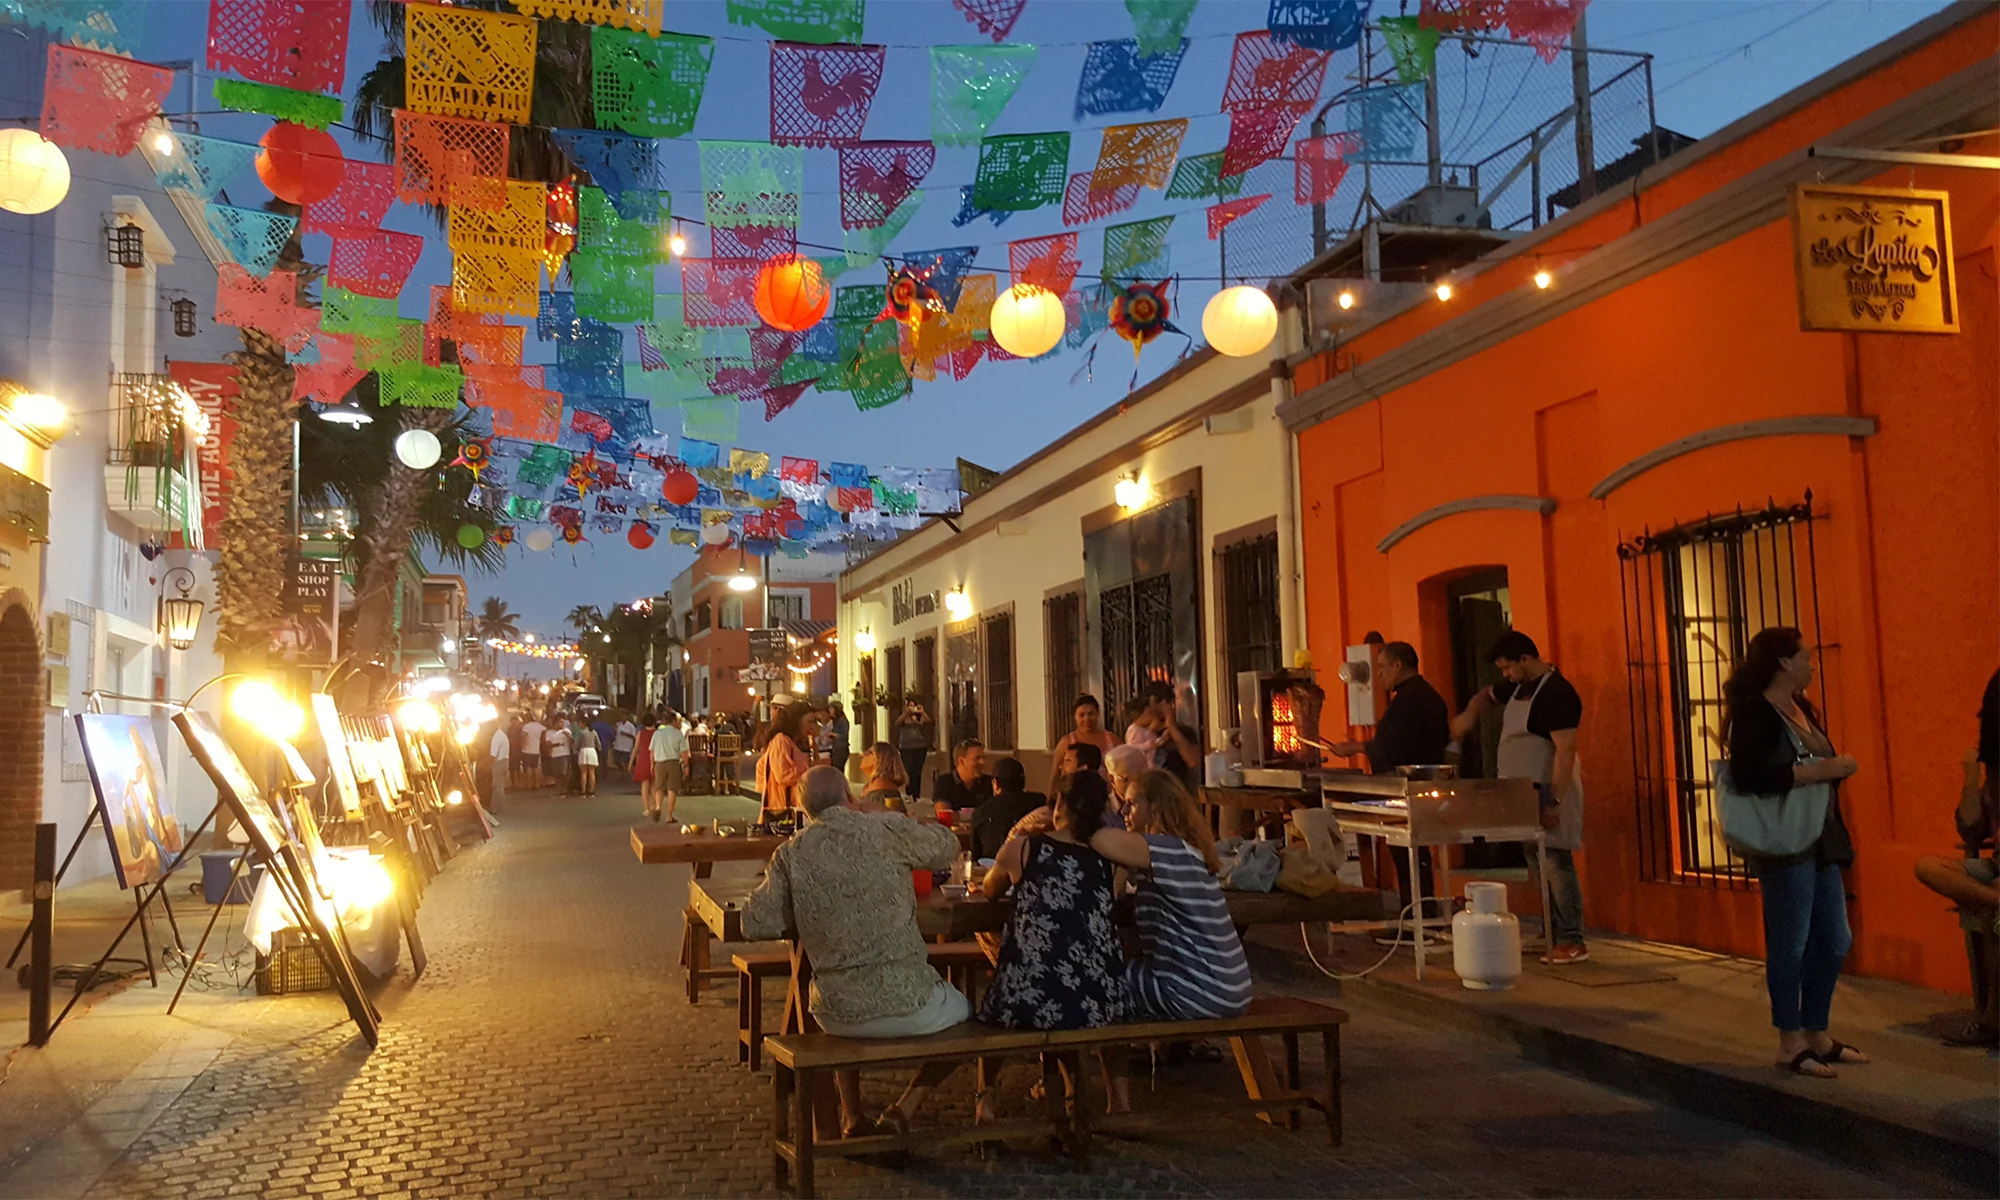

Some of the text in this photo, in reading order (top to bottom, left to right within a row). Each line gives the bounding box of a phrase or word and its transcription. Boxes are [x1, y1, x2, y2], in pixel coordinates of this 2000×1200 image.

[1846, 224, 1940, 278] Lupita
[201, 470, 221, 509] THE
[298, 562, 330, 573] EAT
[297, 575, 330, 585] SHOP
[297, 587, 328, 597] PLAY
